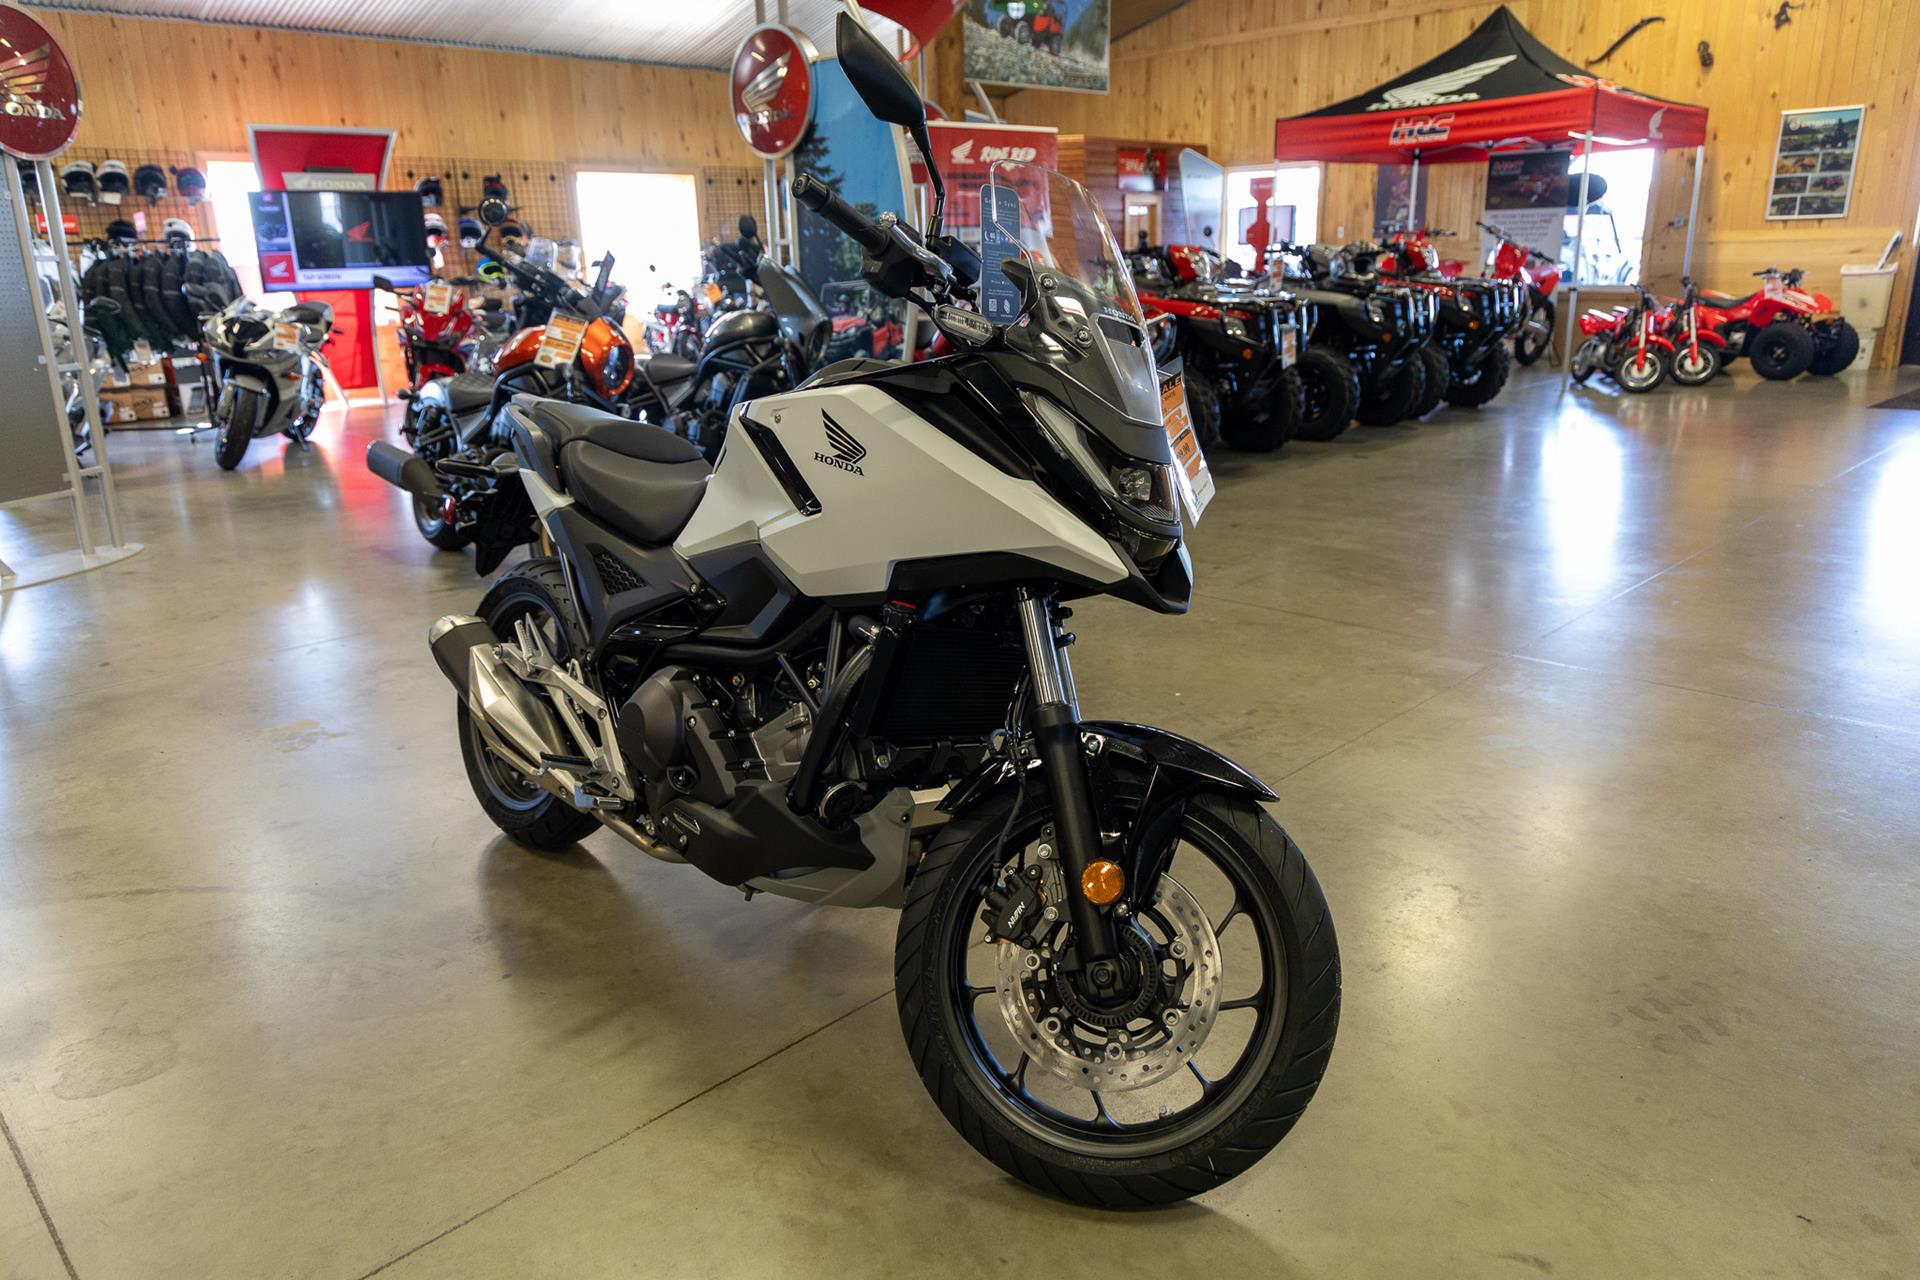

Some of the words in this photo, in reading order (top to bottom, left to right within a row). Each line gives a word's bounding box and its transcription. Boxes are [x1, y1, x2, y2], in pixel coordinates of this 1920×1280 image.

[0, 101, 67, 120] ONDA
[1365, 92, 1480, 112] HONDA
[1391, 112, 1455, 139] HRC
[1010, 146, 1038, 162] RED
[310, 180, 367, 189] HONDA
[1103, 306, 1137, 323] HONDA
[1160, 377, 1182, 394] ALE
[814, 452, 865, 477] HONDA
[1007, 901, 1026, 929] NISSIN
